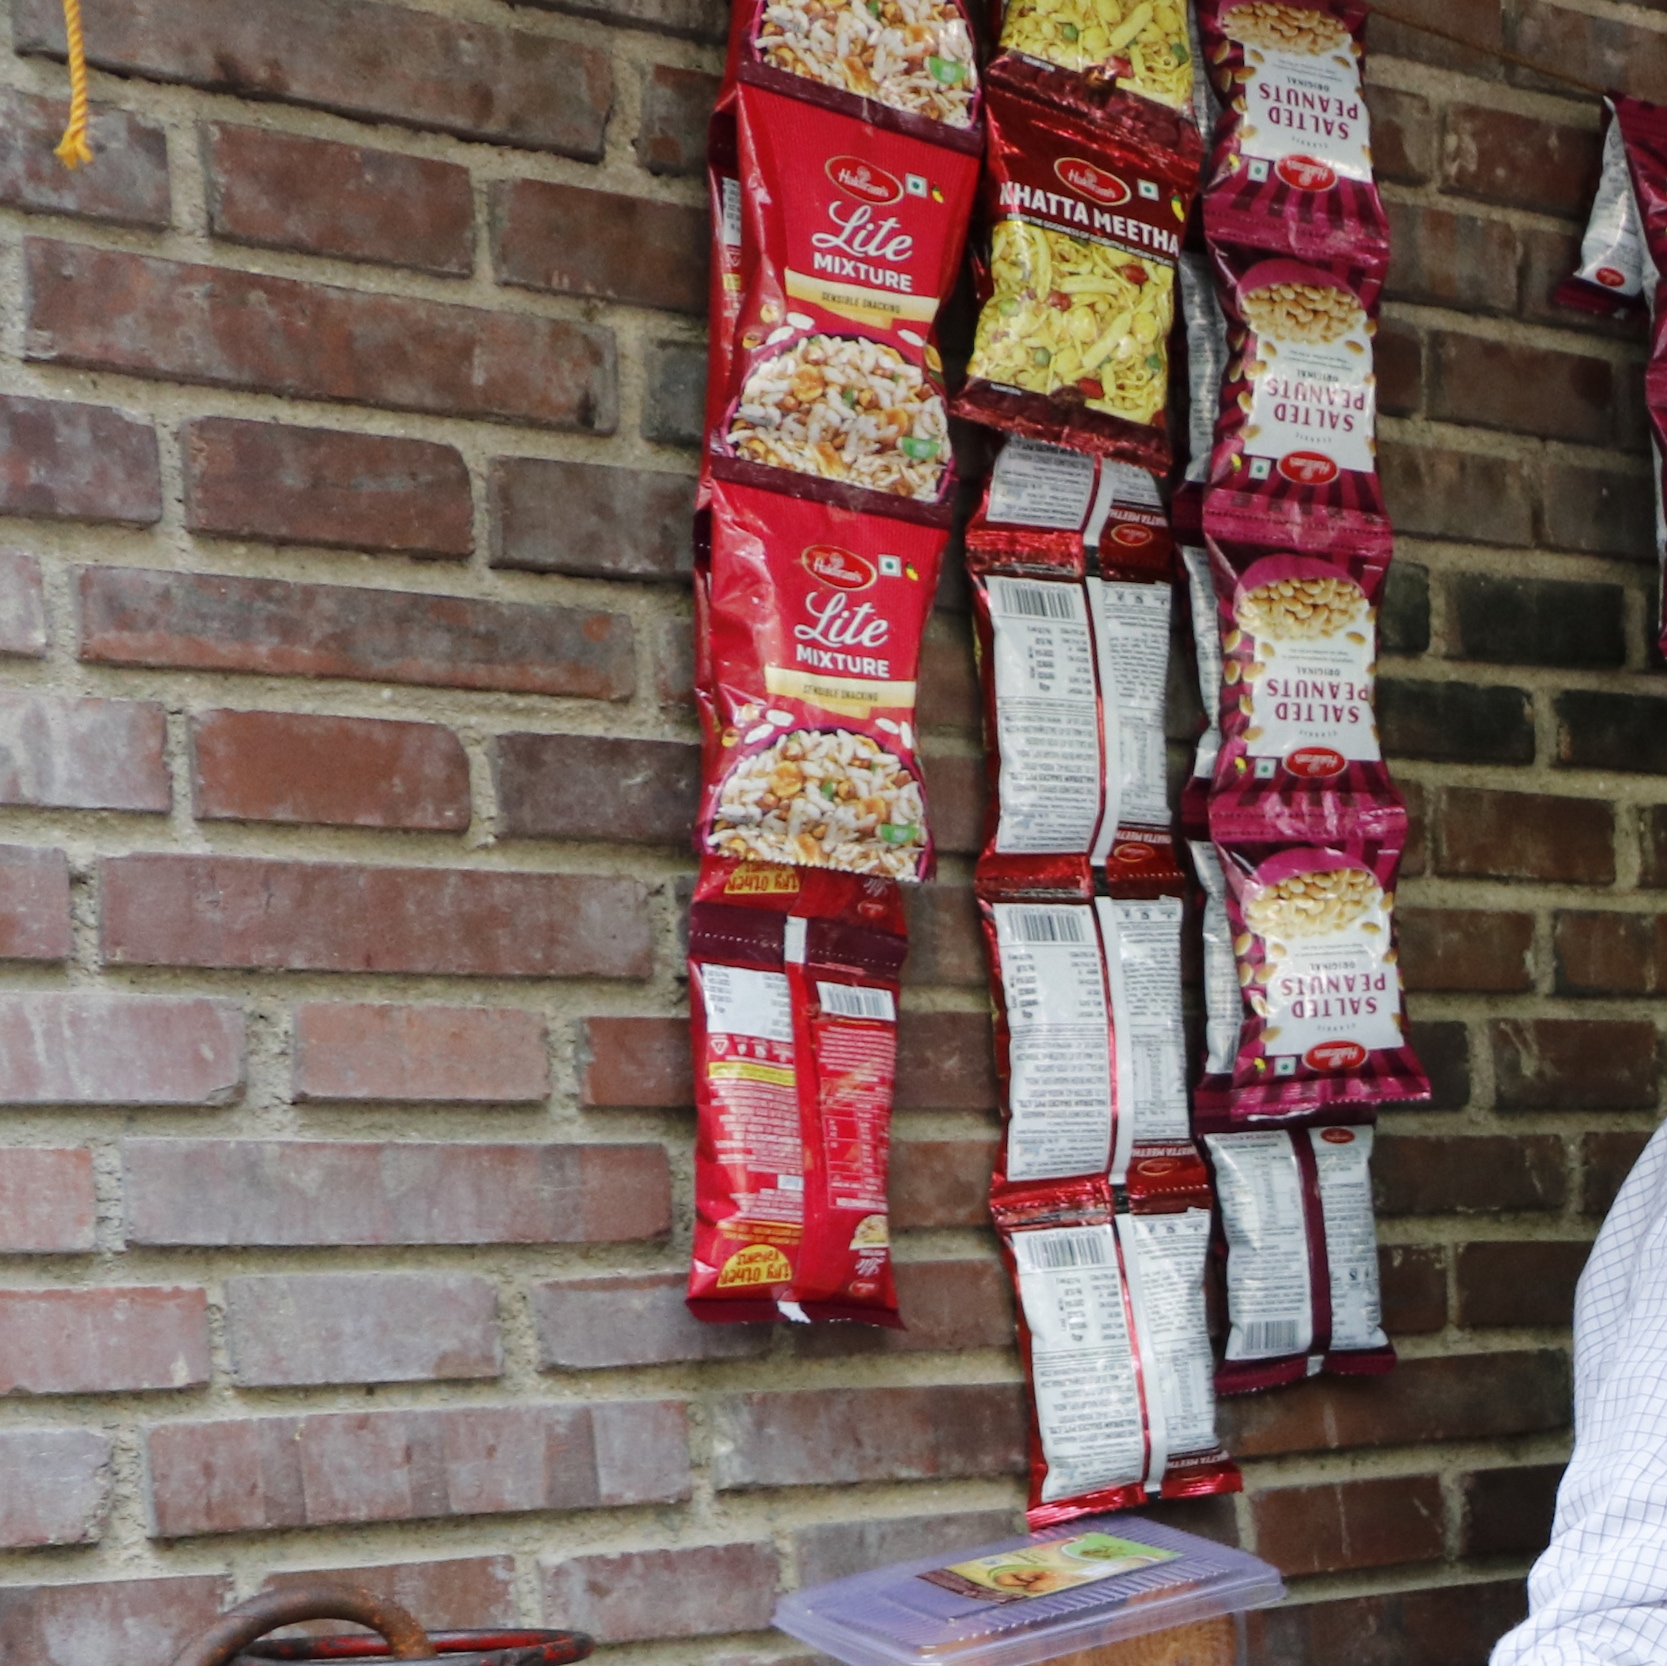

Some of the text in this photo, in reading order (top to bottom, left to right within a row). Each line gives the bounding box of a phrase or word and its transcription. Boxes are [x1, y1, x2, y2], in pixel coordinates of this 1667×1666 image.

[1258, 83, 1358, 121] PEANUTS
[1268, 106, 1349, 140] SALTED
[811, 201, 913, 262] Lite
[1000, 181, 1180, 257] KHATTA MEETHA
[813, 252, 913, 293] MIXTURE
[1266, 377, 1366, 411] PEANUTS
[1274, 403, 1355, 433] SALTED
[794, 591, 889, 648] Lite
[796, 643, 890, 679] MIXTURE
[1266, 679, 1369, 702] PEANUTS
[1275, 702, 1360, 724] SALTED
[1280, 972, 1387, 997] PEANUTS
[1291, 996, 1378, 1020] SALTED
